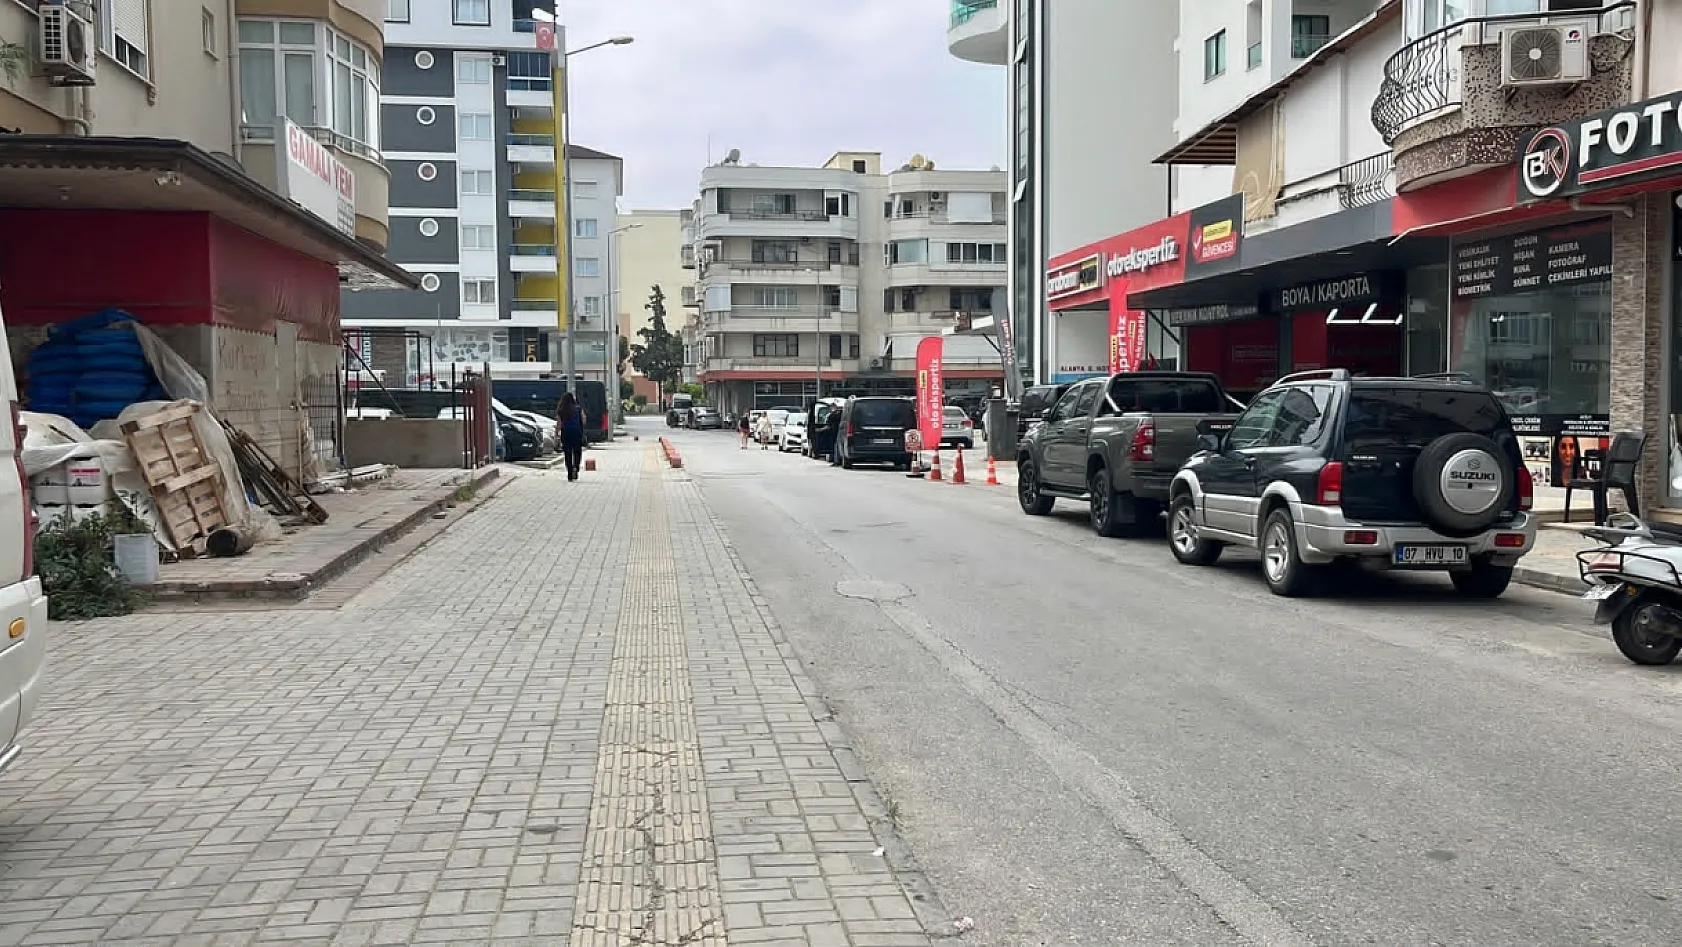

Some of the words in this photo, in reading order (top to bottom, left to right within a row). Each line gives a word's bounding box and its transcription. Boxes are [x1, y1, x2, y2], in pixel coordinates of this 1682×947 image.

[1579, 101, 1682, 168] FOT
[1282, 286, 1311, 306] BOYA
[1318, 276, 1371, 301] KAPORTA
[1450, 471, 1496, 481] SUZUKI
[1405, 547, 1418, 560] 07
[1424, 547, 1444, 560] HVU
[1452, 547, 1463, 560] 10
